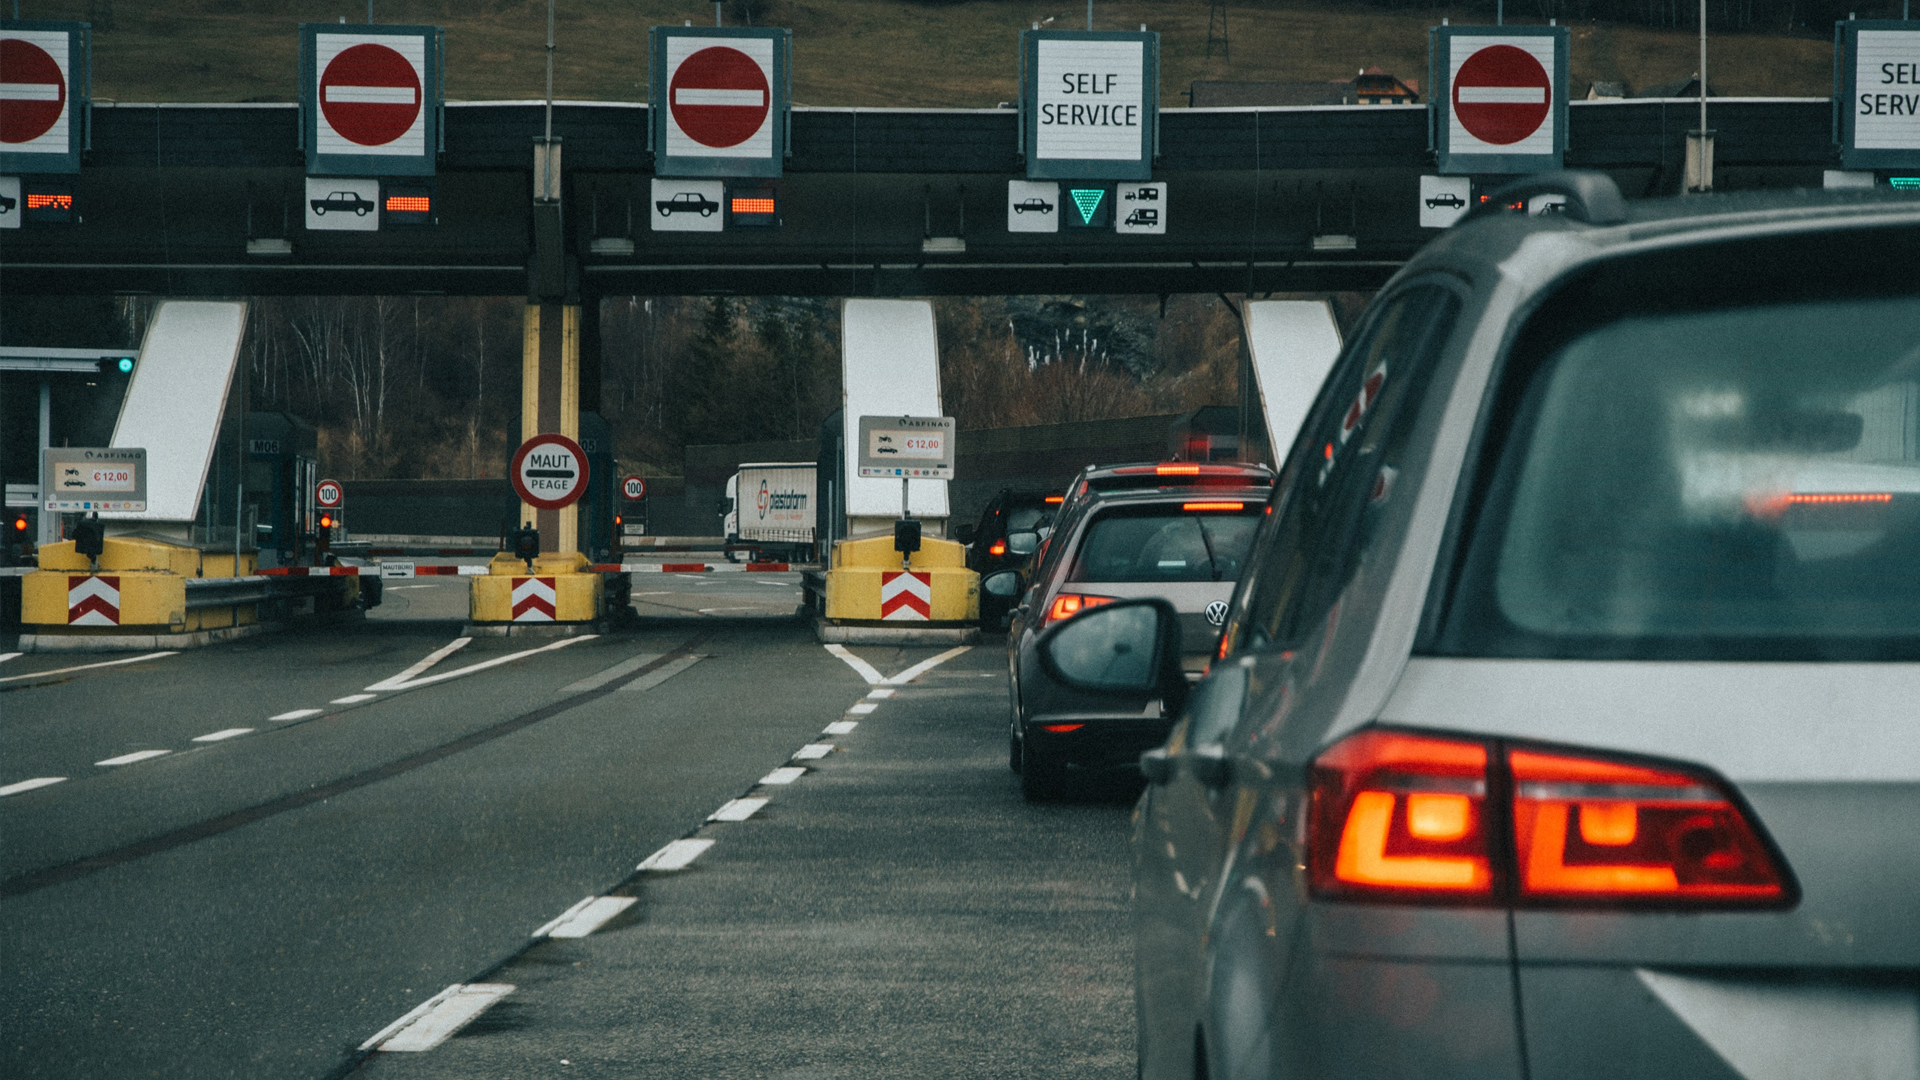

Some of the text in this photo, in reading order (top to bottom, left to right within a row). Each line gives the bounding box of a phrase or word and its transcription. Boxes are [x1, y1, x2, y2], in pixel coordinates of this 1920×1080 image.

[1881, 62, 1920, 84] SEL
[1062, 72, 1118, 94] SELF
[1860, 93, 1920, 116] SERV
[1041, 103, 1138, 126] SERVICE
[254, 440, 278, 452] M06
[906, 439, 939, 450] € 12,00
[530, 454, 571, 468] MAUT
[93, 472, 128, 482] € 12,00
[531, 479, 568, 490] PEAGE
[627, 482, 642, 494] 100
[321, 488, 337, 500] 100
